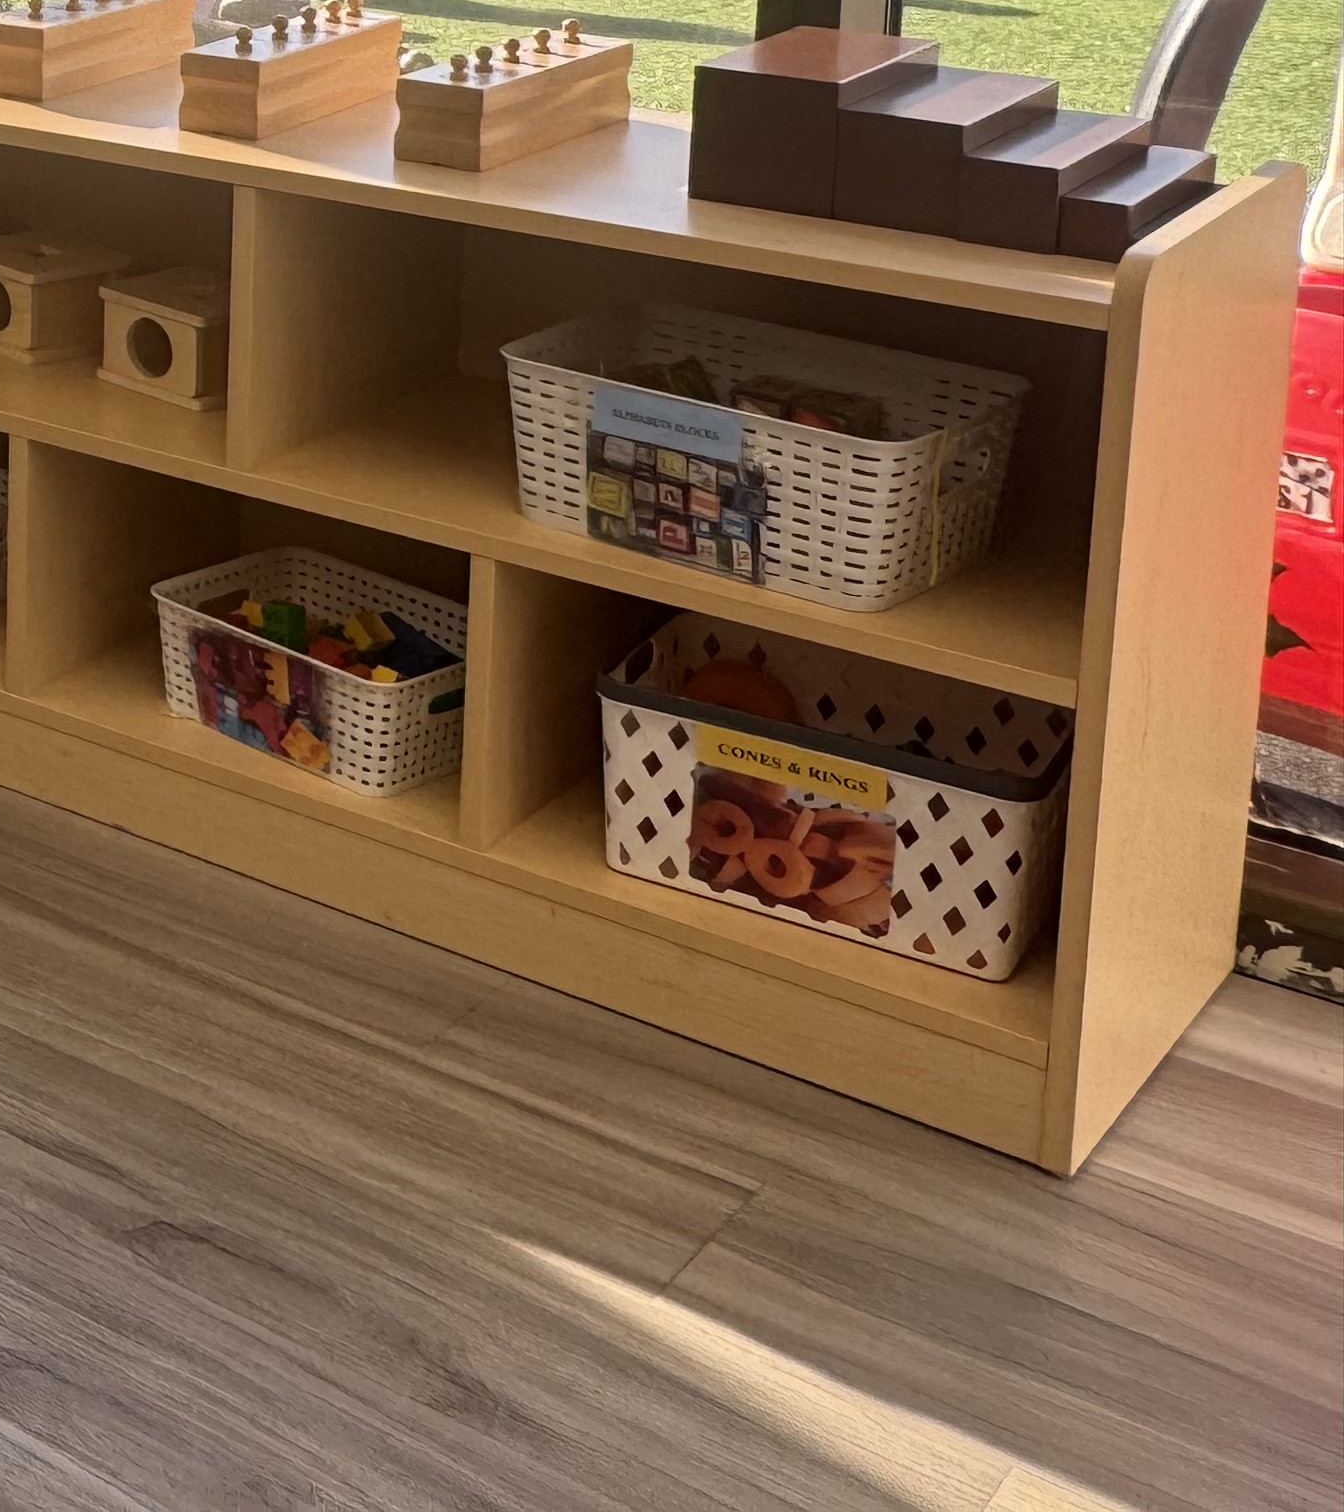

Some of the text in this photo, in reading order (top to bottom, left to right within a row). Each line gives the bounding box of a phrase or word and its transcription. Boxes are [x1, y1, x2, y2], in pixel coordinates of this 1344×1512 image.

[717, 742, 869, 794] CONES & RINGS
